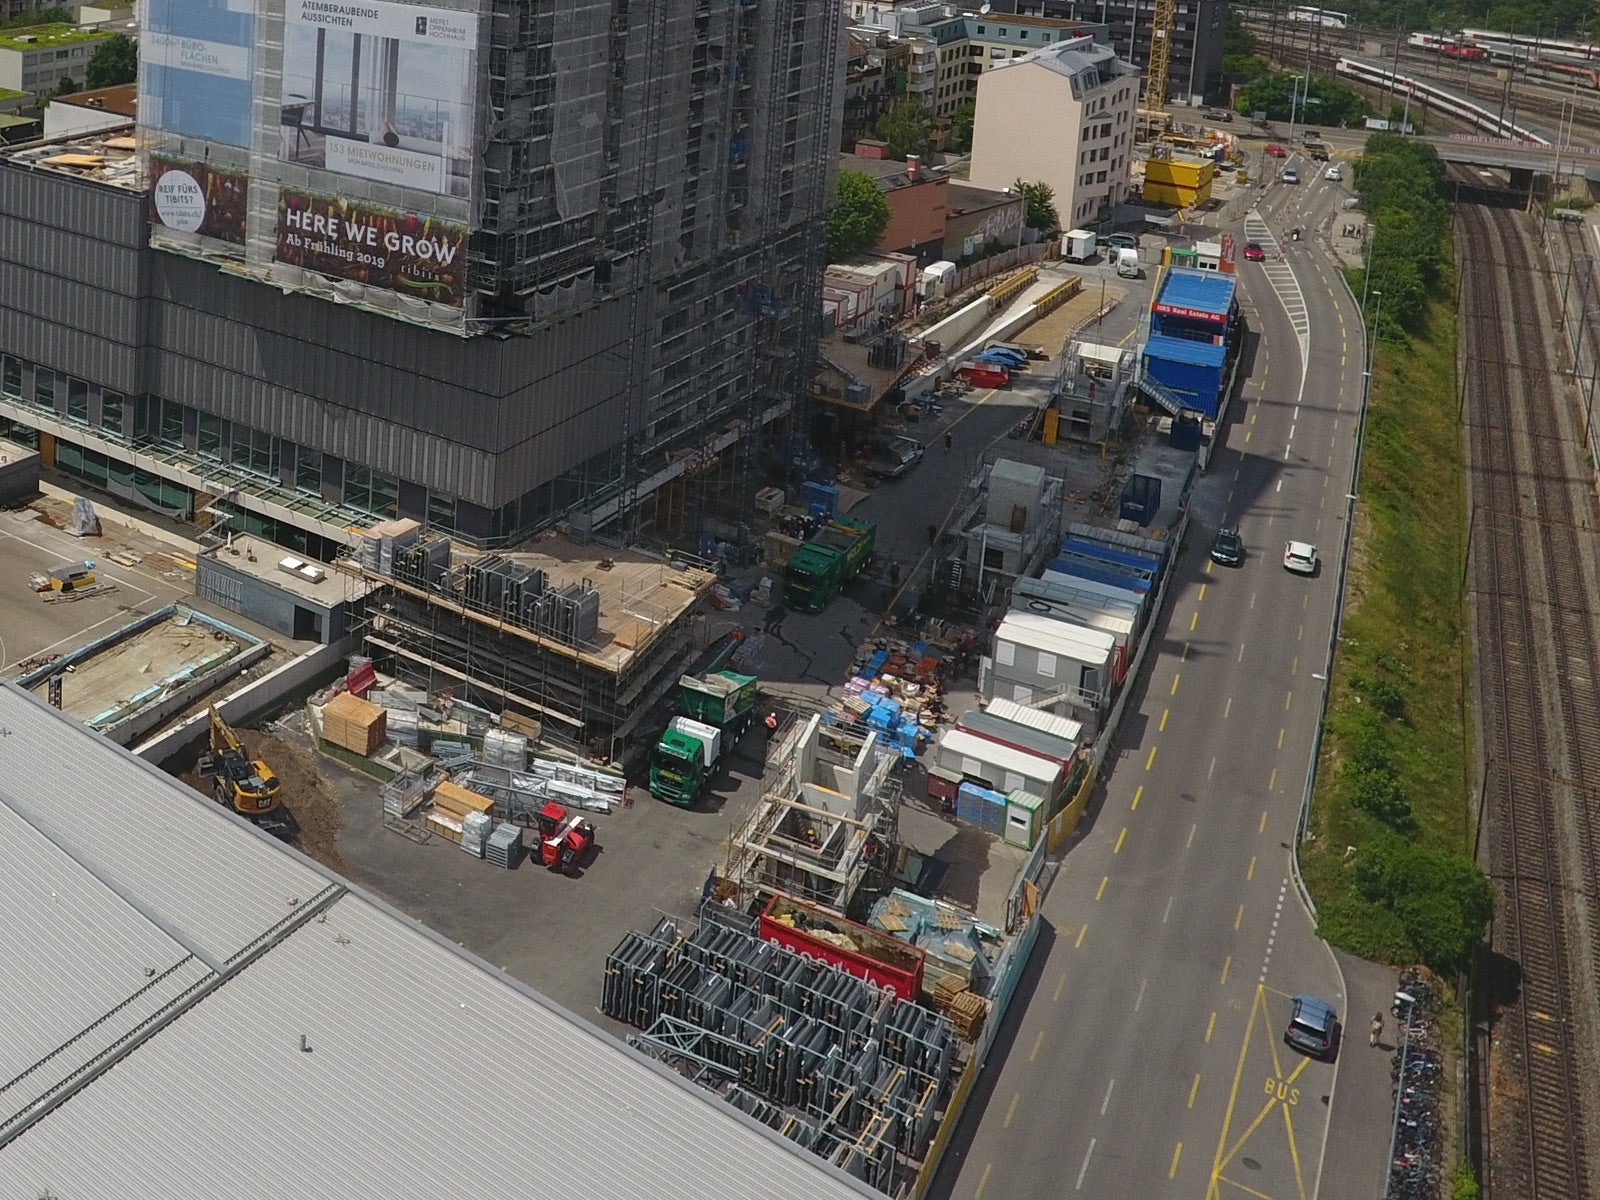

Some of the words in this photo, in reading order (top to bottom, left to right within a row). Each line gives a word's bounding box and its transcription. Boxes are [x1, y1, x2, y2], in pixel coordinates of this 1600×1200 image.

[301, 0, 379, 19] ATEMBERAUBENDE
[301, 11, 353, 27] AUSSICHTEN
[180, 50, 218, 65] FLÄCHEN
[329, 143, 345, 154] 153
[347, 146, 435, 172] MIETWOHNUNGEN
[159, 184, 175, 194] REIF
[177, 183, 198, 194] FÜRS
[165, 195, 194, 204] TIBITS?
[286, 207, 339, 237] HERE
[344, 221, 378, 247] WE
[384, 231, 457, 265] GROW
[286, 233, 302, 246] Ab
[303, 237, 354, 262] Frühling
[356, 252, 385, 268] 2019
[1264, 1078, 1300, 1106] BUS
